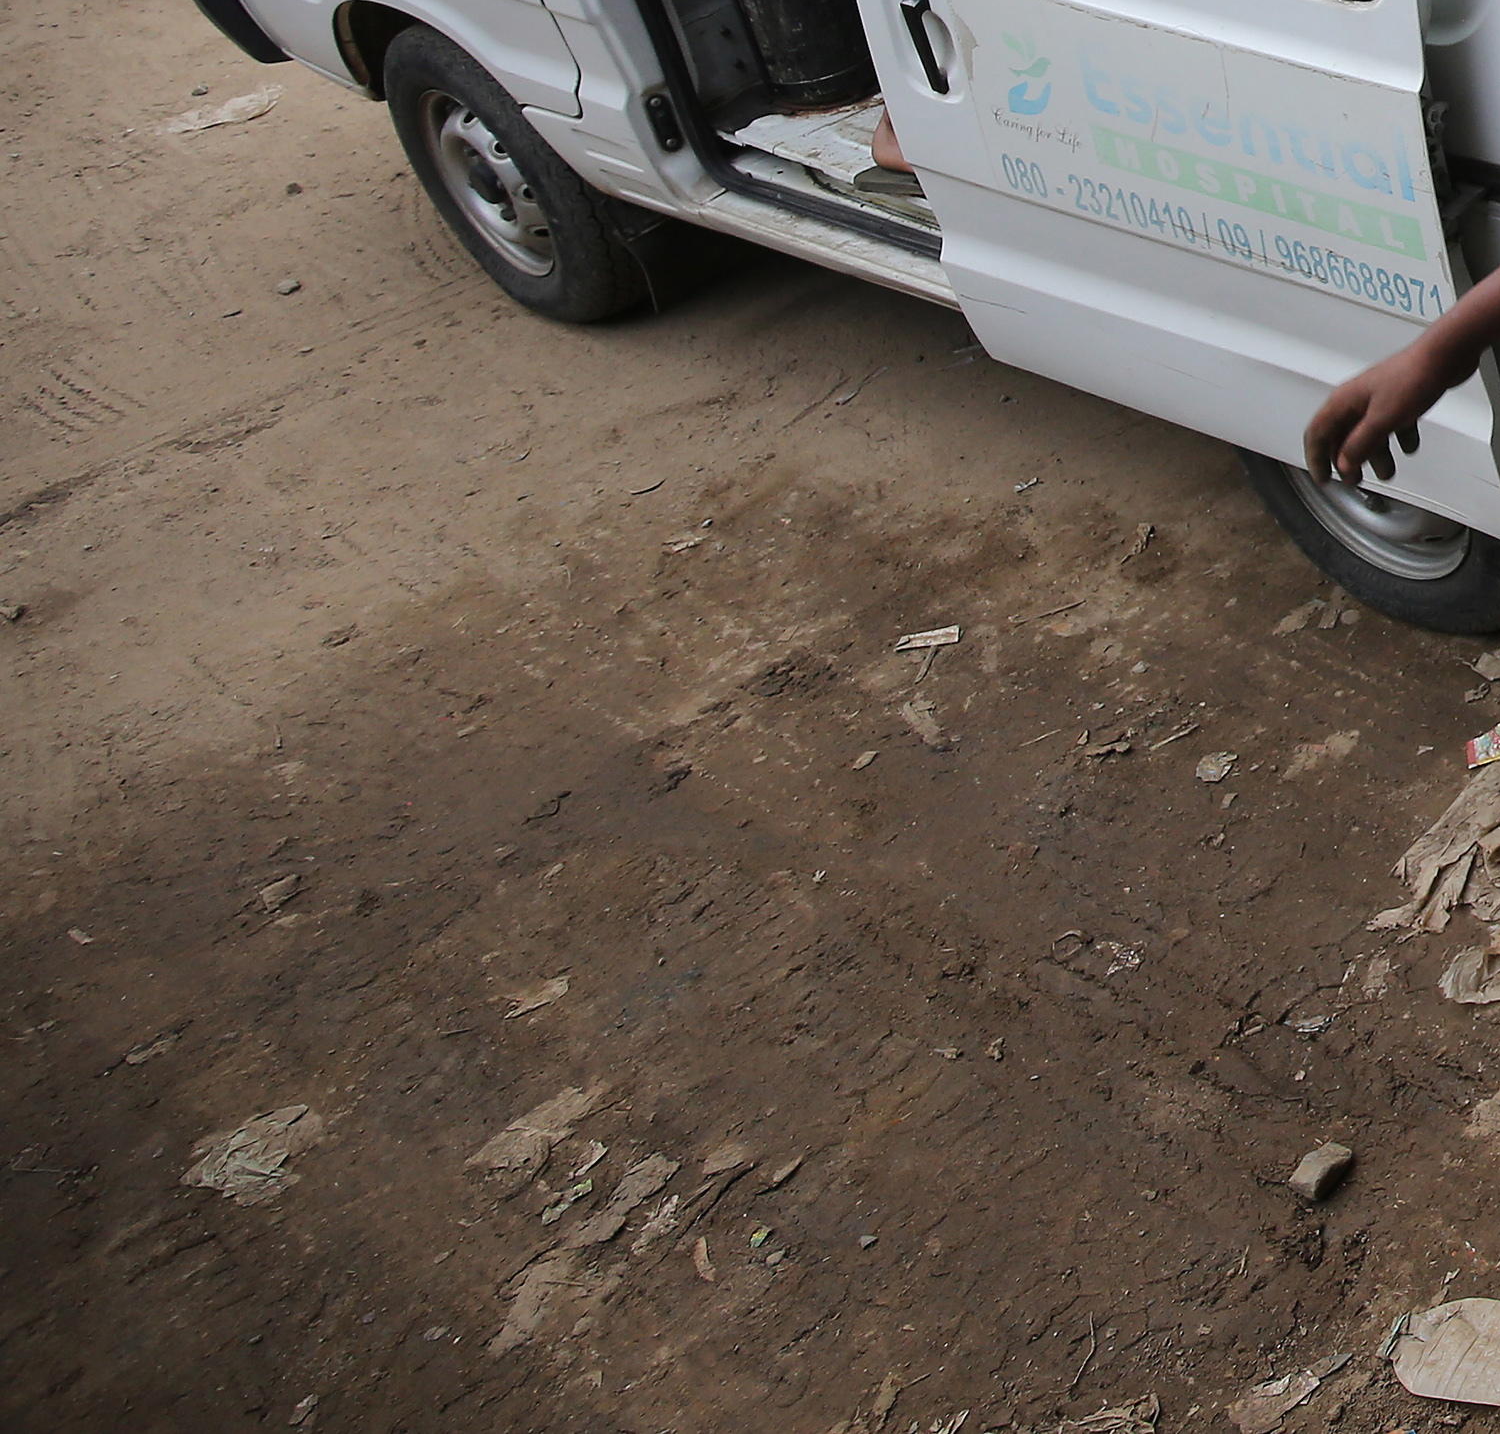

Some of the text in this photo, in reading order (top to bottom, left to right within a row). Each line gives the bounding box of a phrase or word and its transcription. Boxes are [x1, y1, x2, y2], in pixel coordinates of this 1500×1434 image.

[1001, 153, 1049, 199] 080
[1068, 173, 1197, 244] 23210410
[1216, 218, 1253, 261] 09
[1274, 234, 1444, 317] 9686688971
[1113, 134, 1406, 251] HOSPITAL
